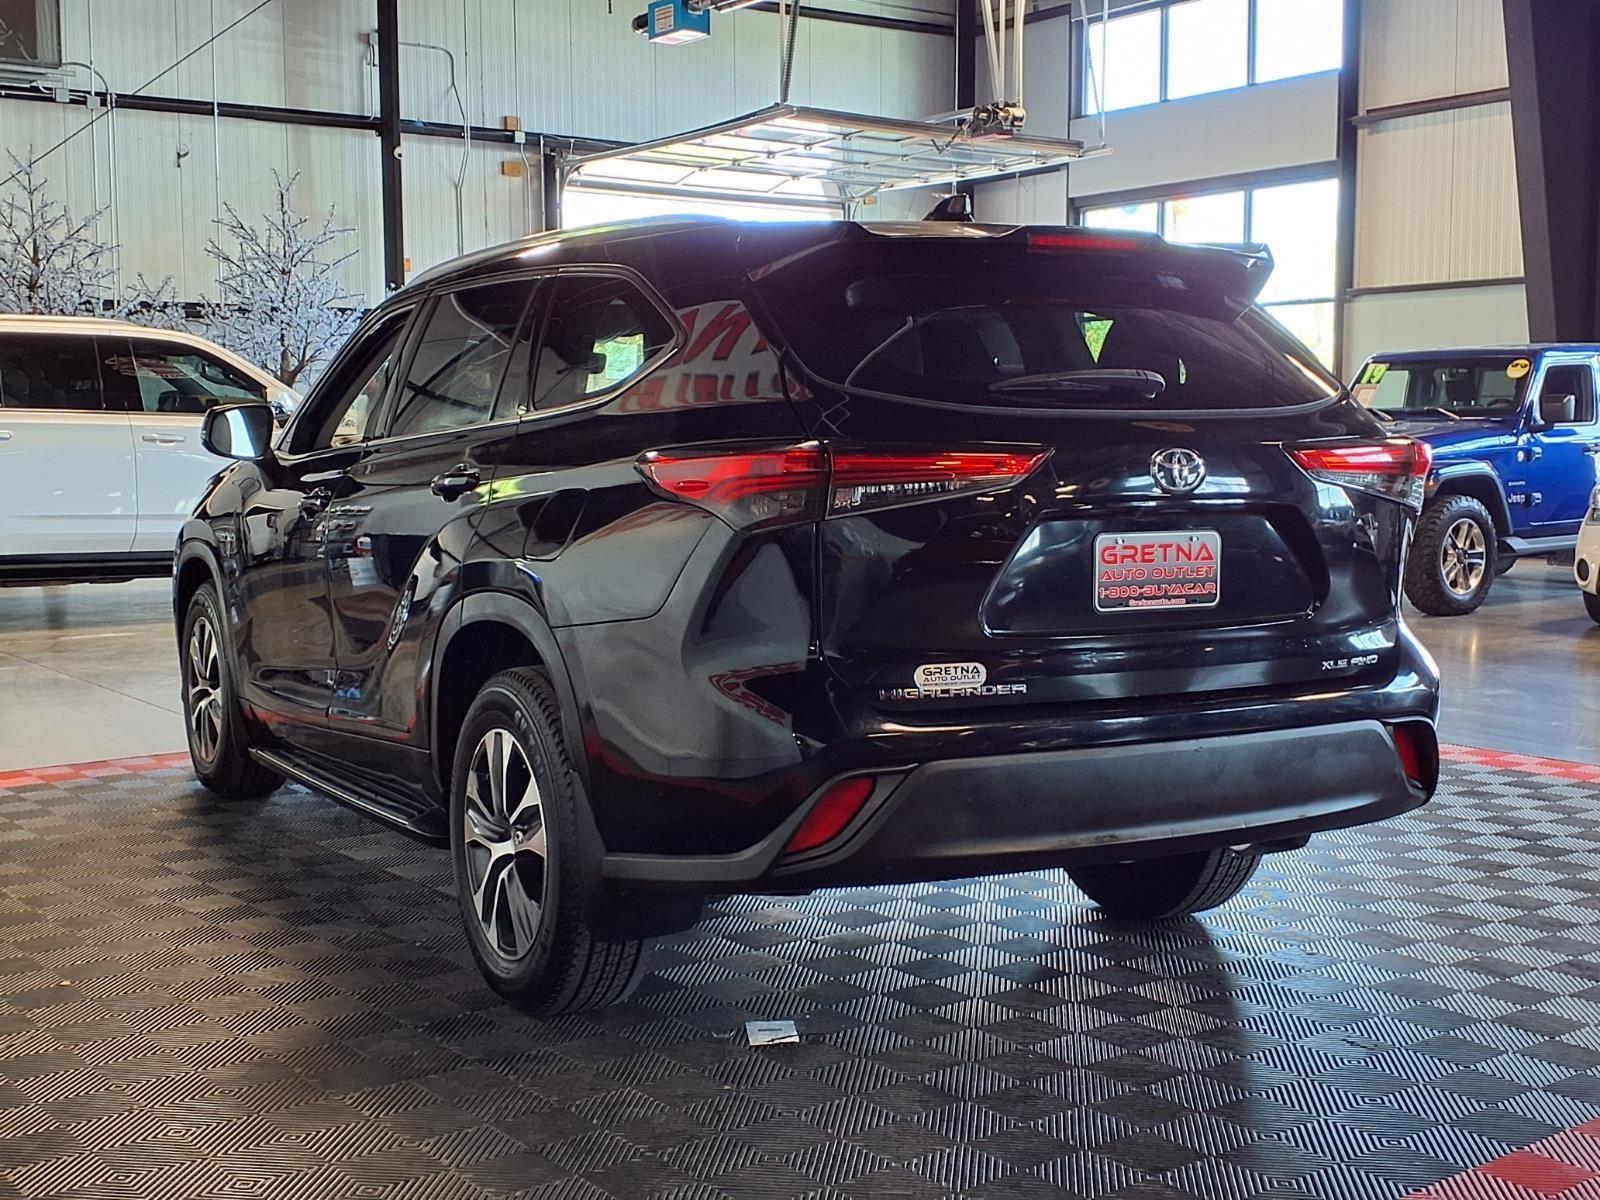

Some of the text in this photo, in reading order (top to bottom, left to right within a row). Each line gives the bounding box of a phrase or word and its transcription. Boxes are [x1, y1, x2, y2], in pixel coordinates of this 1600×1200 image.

[1508, 493, 1525, 504] Jeep
[1101, 543, 1216, 565] GRETNA
[1101, 565, 1216, 581] AUTO OUTLET
[1099, 582, 1216, 598] 1-800-BUYACAR
[923, 665, 981, 676] GRETNA
[1322, 659, 1348, 670] XLE
[879, 683, 1027, 700] HIGHLANDER
